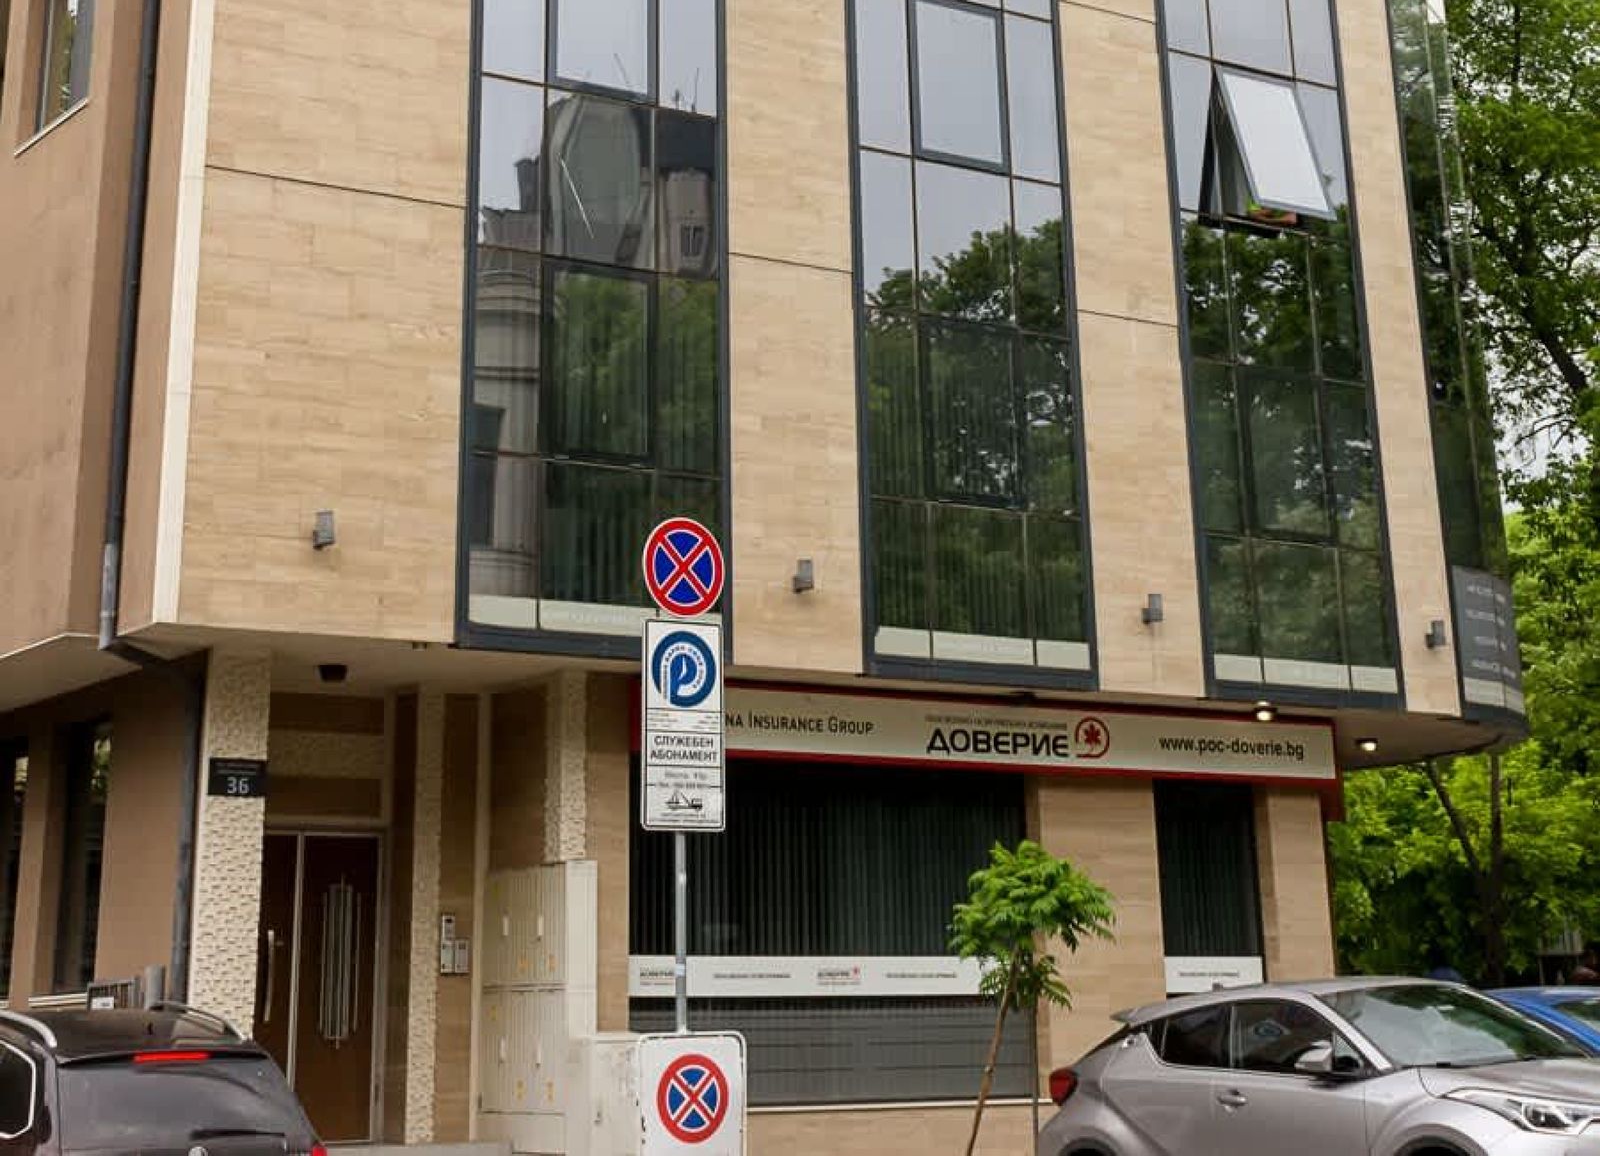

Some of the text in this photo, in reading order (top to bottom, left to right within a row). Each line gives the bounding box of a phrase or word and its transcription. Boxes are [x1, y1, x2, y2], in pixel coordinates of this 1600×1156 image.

[653, 735, 714, 748] СЛУЖЕБЕН
[926, 727, 1069, 758] ДОВЕРИЕ
[1158, 736, 1305, 762] www.poc-doverie.bg
[650, 750, 718, 762] АБОНАМЕНТ
[226, 776, 250, 794] 36
